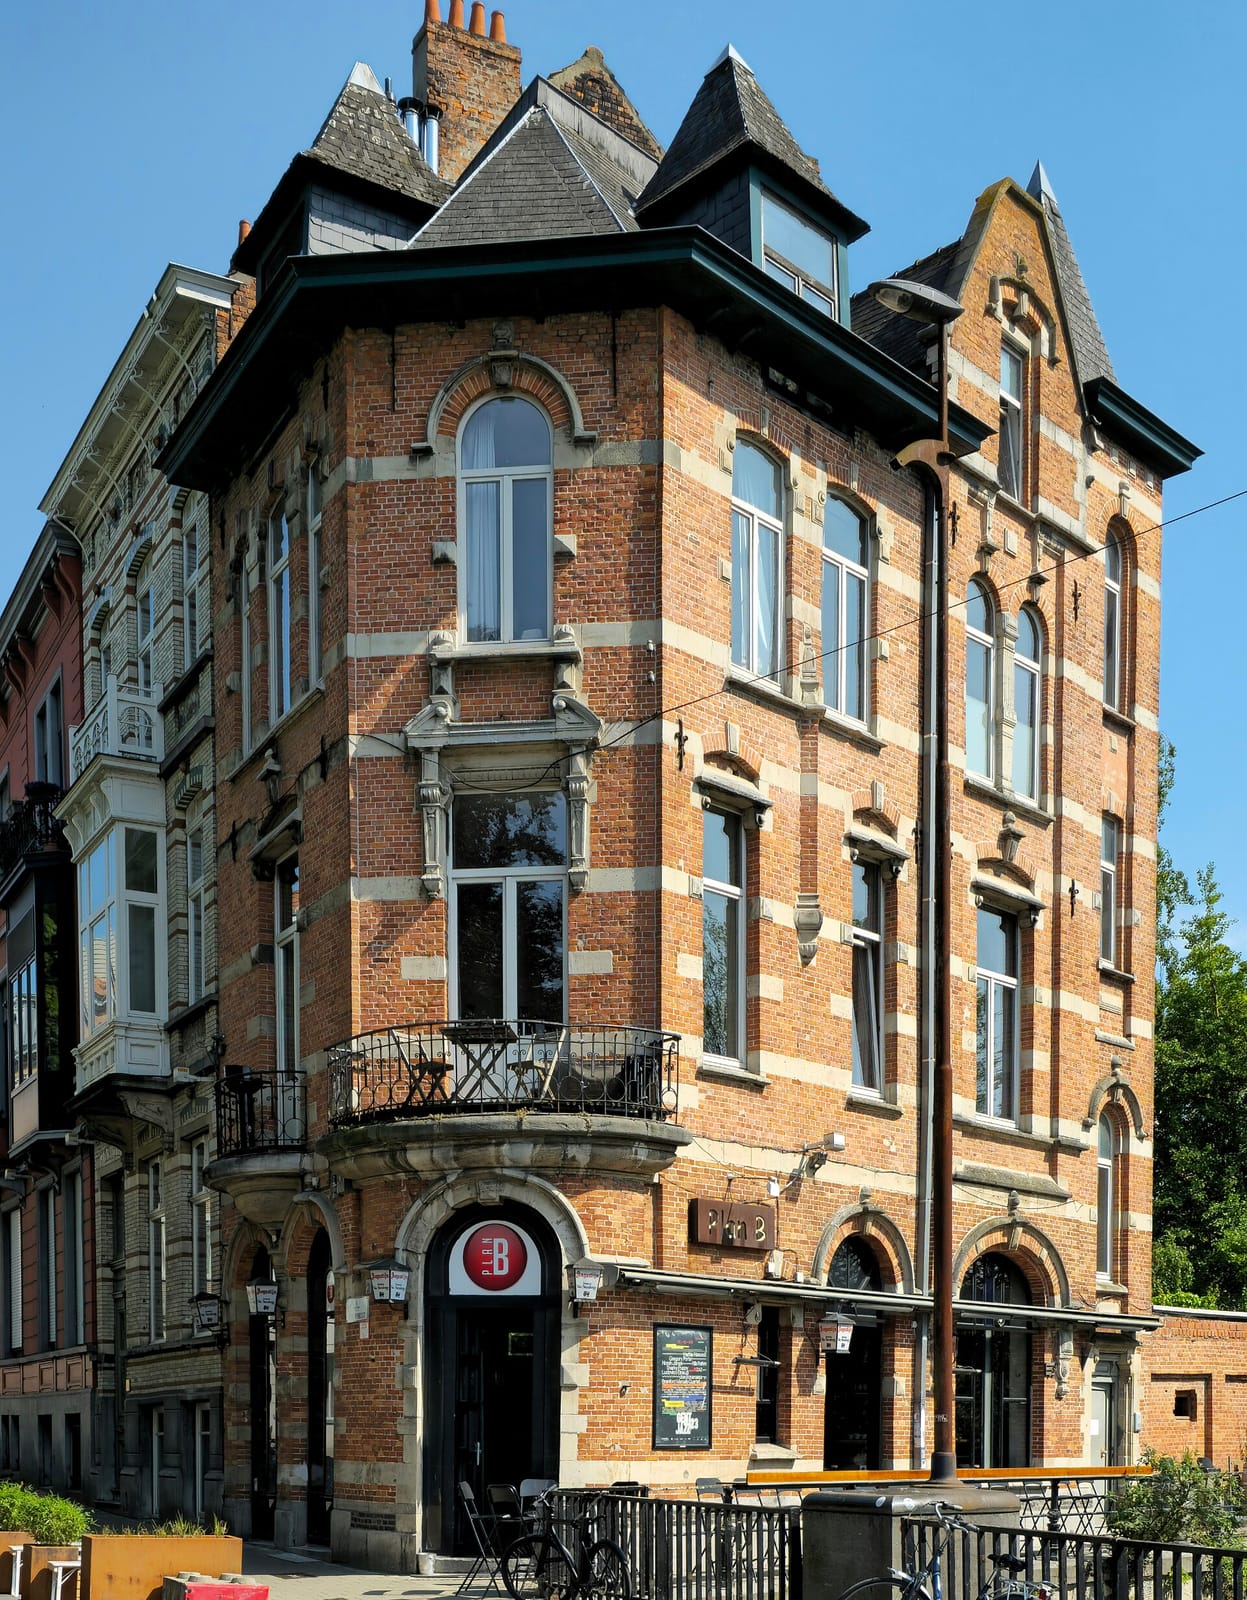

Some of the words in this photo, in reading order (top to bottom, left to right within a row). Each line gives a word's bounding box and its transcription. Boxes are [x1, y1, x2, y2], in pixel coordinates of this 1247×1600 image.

[708, 1208, 748, 1241] Plan
[755, 1215, 766, 1242] B
[481, 1238, 493, 1276] PLAN
[493, 1237, 509, 1276] B
[675, 1421, 692, 1435] JAZZ
